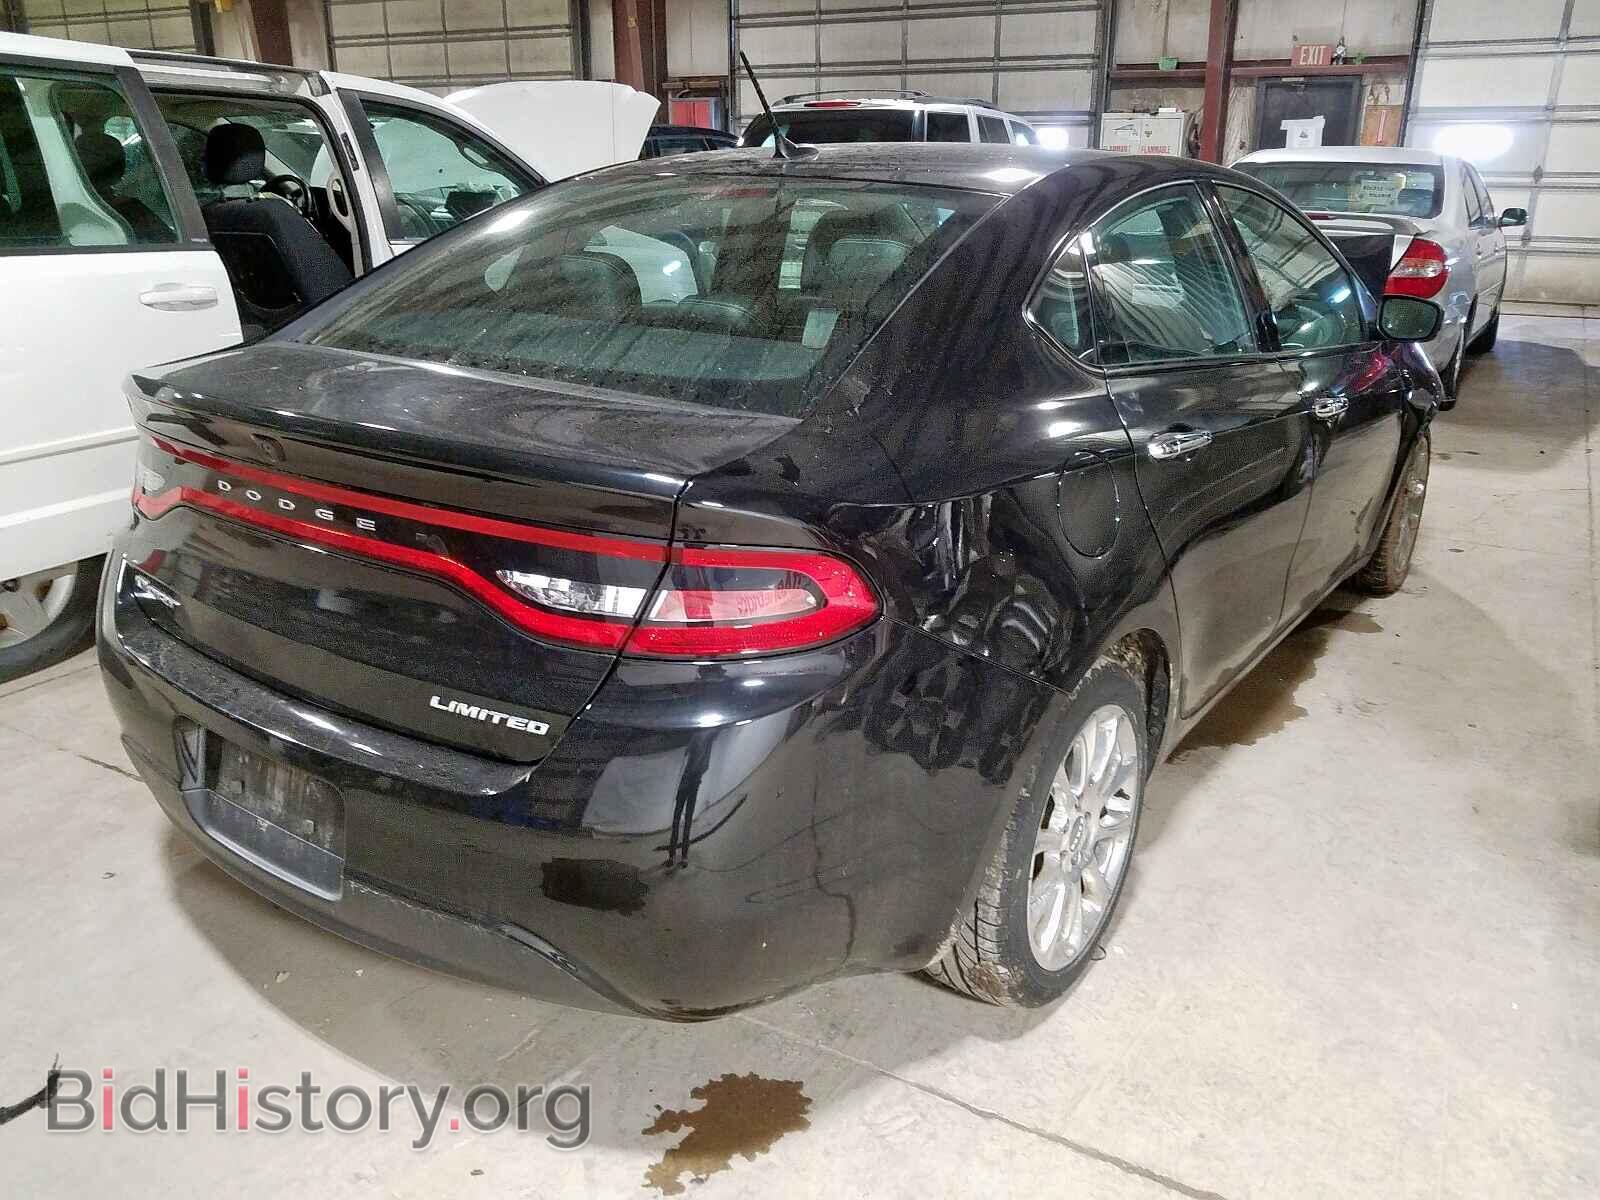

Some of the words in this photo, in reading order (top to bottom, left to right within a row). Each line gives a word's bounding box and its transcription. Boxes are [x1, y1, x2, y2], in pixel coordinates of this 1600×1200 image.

[1300, 45, 1328, 65] EXIT
[217, 479, 376, 532] DODGE
[429, 695, 551, 736] LIMITED
